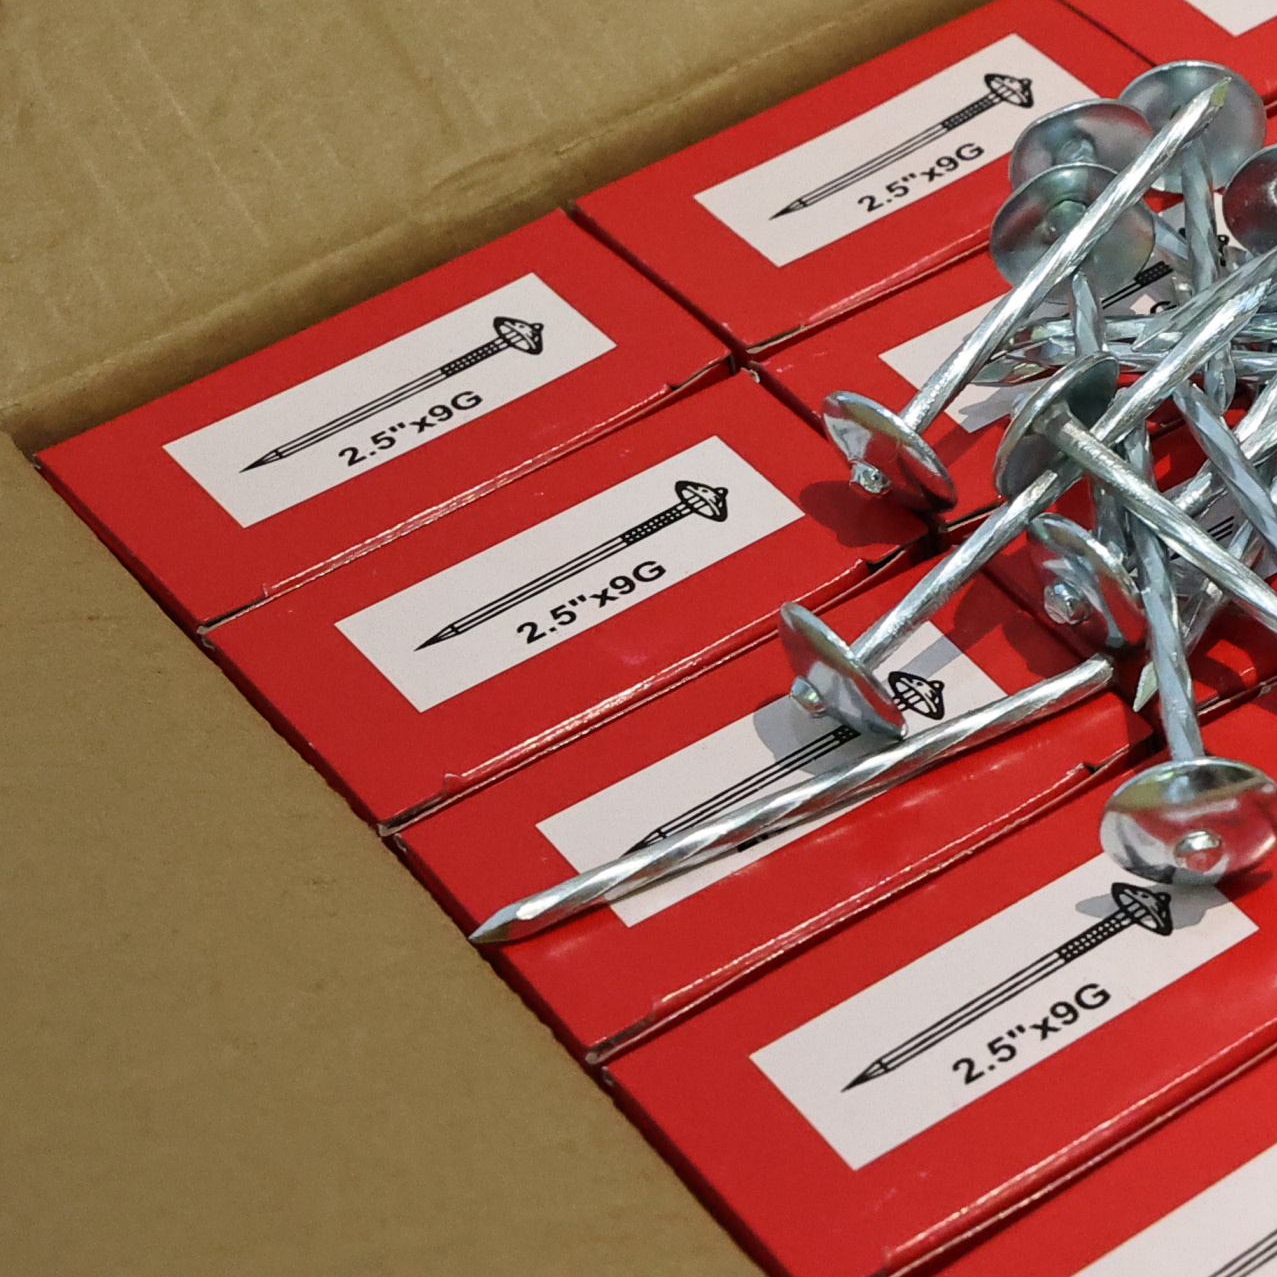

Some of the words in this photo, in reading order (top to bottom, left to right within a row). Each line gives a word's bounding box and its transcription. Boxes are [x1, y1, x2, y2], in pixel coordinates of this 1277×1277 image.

[858, 143, 984, 212] 2.5"x9G
[339, 391, 483, 466] 2.5"x9G
[517, 561, 666, 644] 2.5"x9G
[952, 983, 1111, 1085] 2.5"x9G
